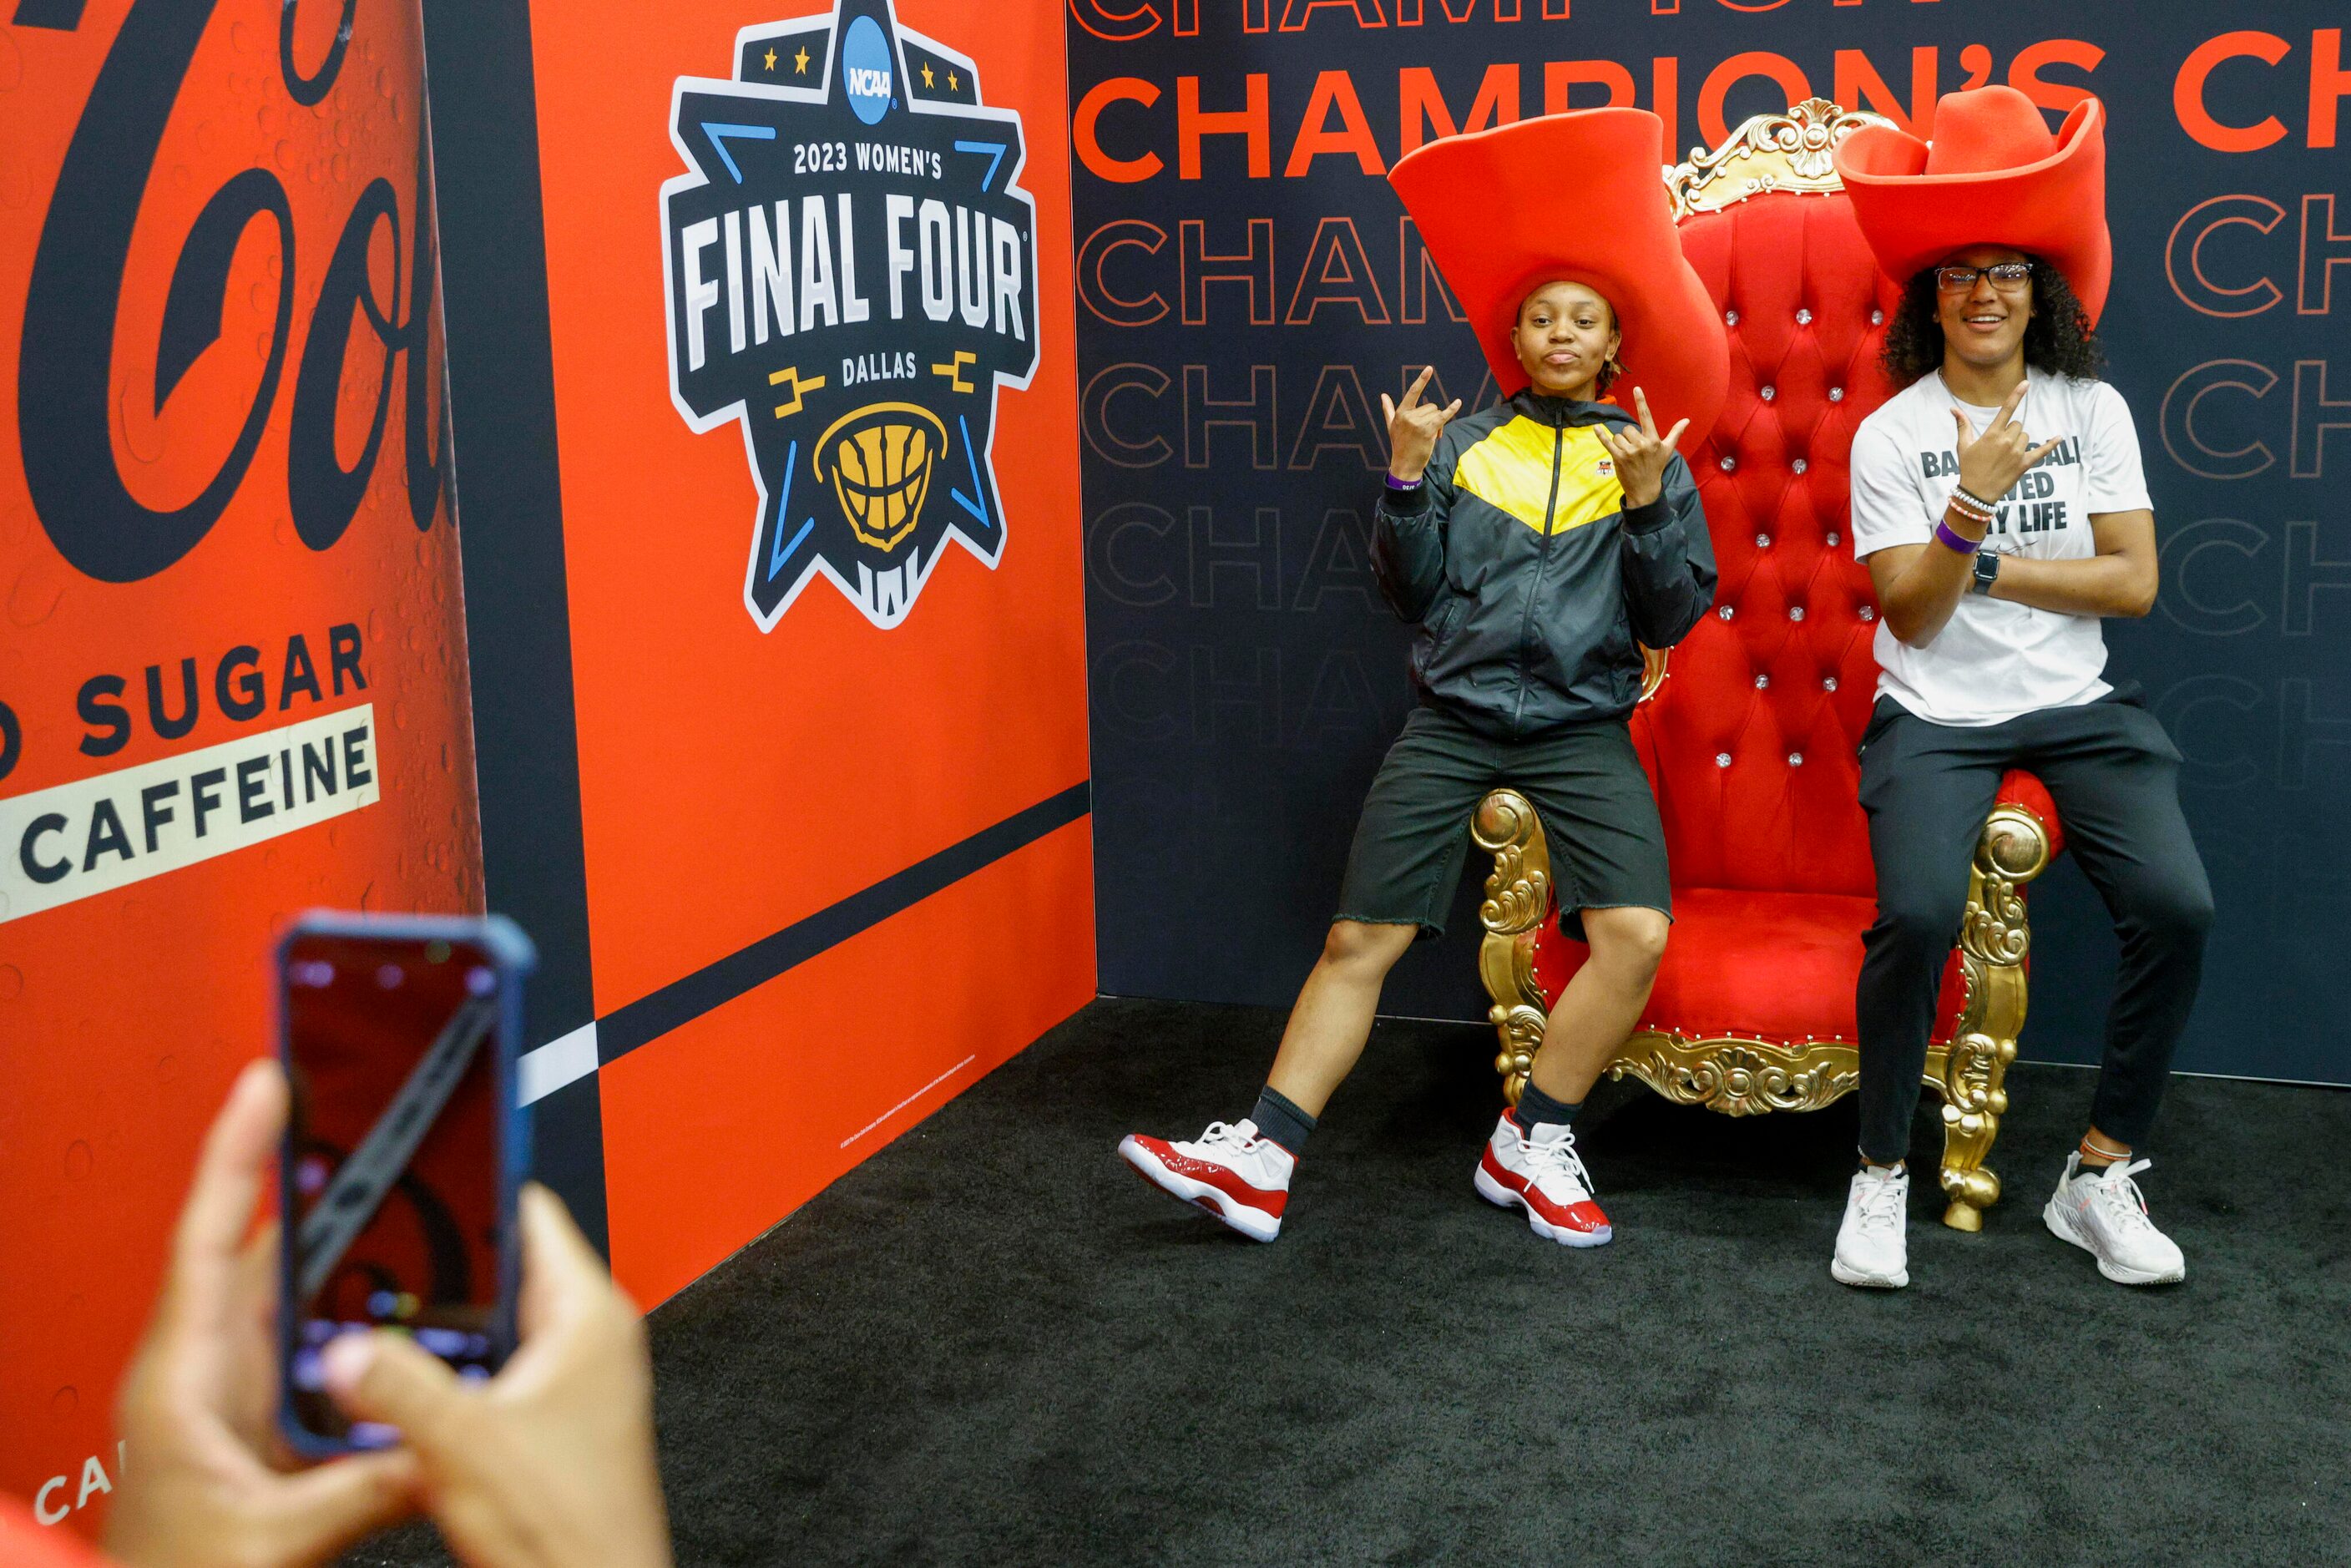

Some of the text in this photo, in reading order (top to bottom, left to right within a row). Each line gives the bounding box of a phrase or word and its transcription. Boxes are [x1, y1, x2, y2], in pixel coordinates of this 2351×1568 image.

[849, 67, 892, 99] NCAA
[793, 141, 943, 180] 2023 WOMEN'S
[681, 193, 1027, 372] FINAL FOUR
[842, 352, 917, 387] DALLAS
[2019, 500, 2067, 533] LIFE
[76, 622, 367, 757] SUGAR
[18, 725, 372, 884] CAFFEINE
[35, 1439, 126, 1526] CA
